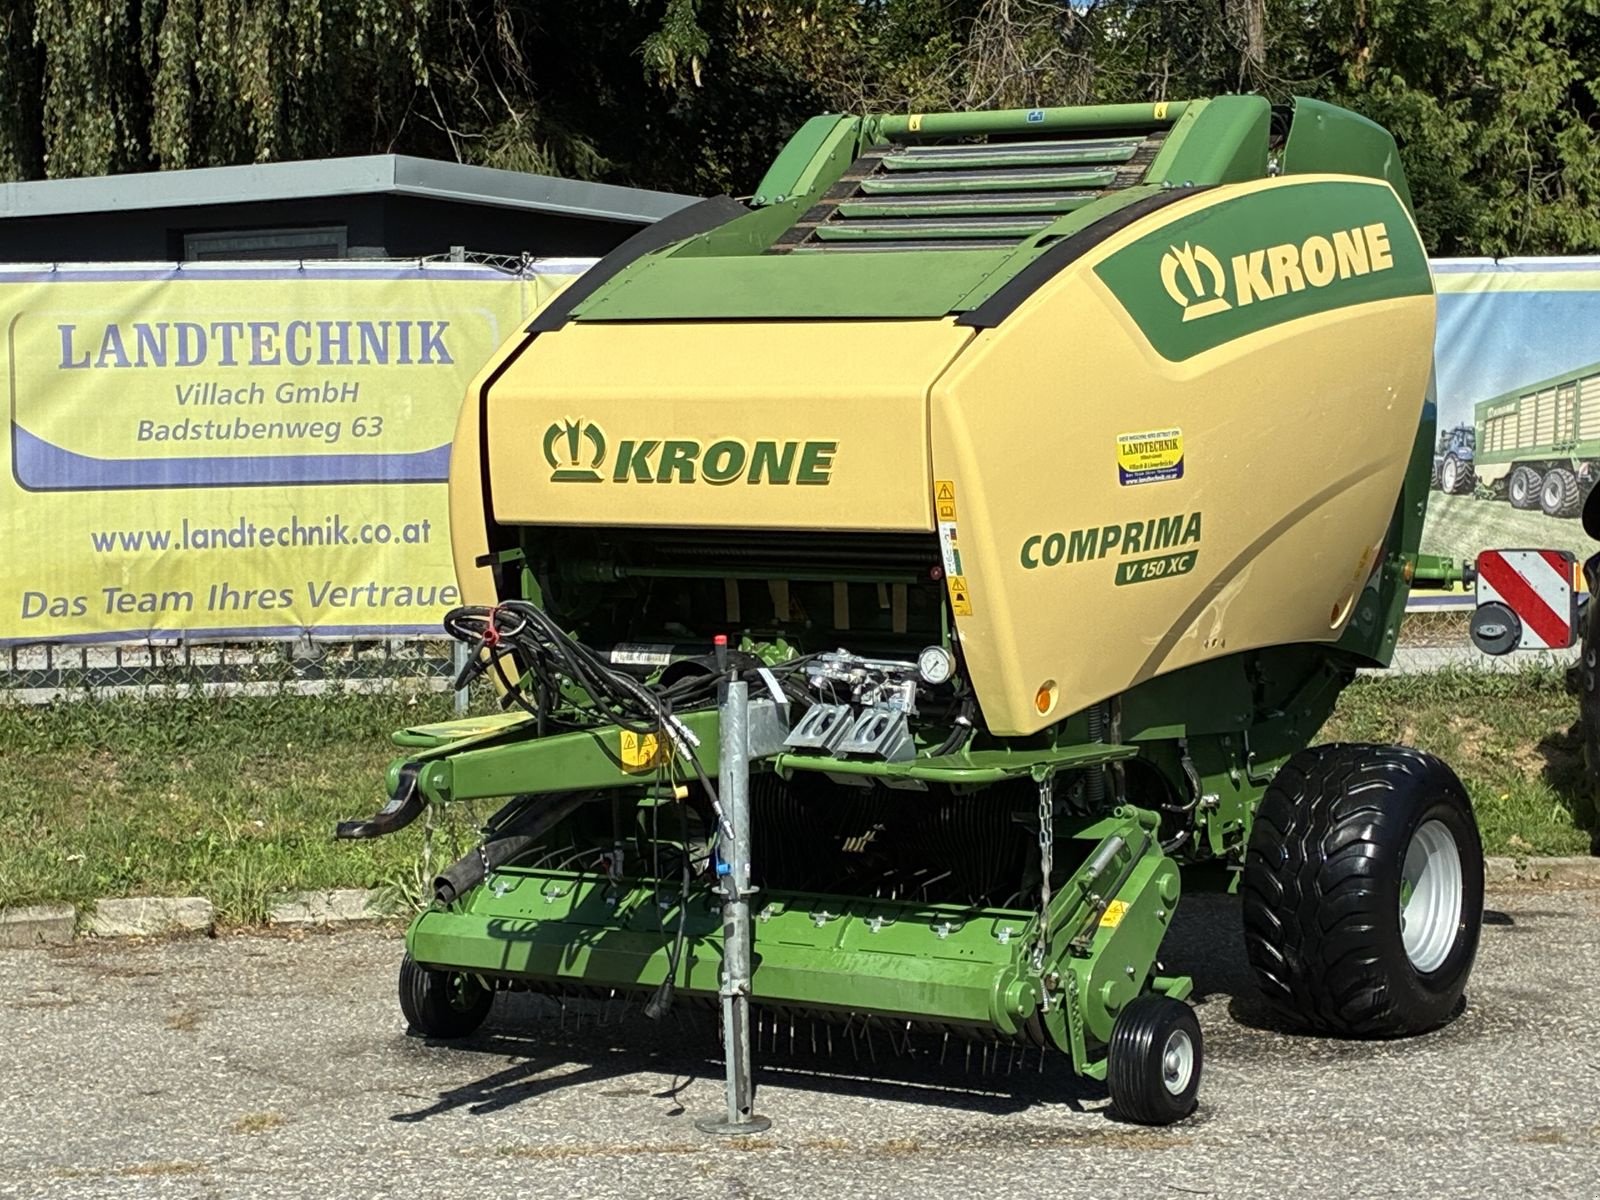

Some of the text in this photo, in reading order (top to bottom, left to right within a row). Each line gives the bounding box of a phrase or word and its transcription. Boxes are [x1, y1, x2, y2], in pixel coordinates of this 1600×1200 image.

[1232, 222, 1394, 306] KRONE
[58, 321, 454, 370] LANDTECHNIK
[175, 382, 359, 406] Villach GmbH
[137, 416, 384, 444] Badstubenweg 63
[1122, 438, 1179, 456] LANDTECHNIK
[613, 440, 840, 486] KRONE
[91, 515, 431, 552] www.landtechnik.co.at
[1020, 511, 1202, 569] COMPRIMA
[1125, 555, 1190, 581] V 150 XC
[22, 591, 87, 619] Das
[102, 585, 193, 615] Team
[208, 582, 293, 612] Ihres
